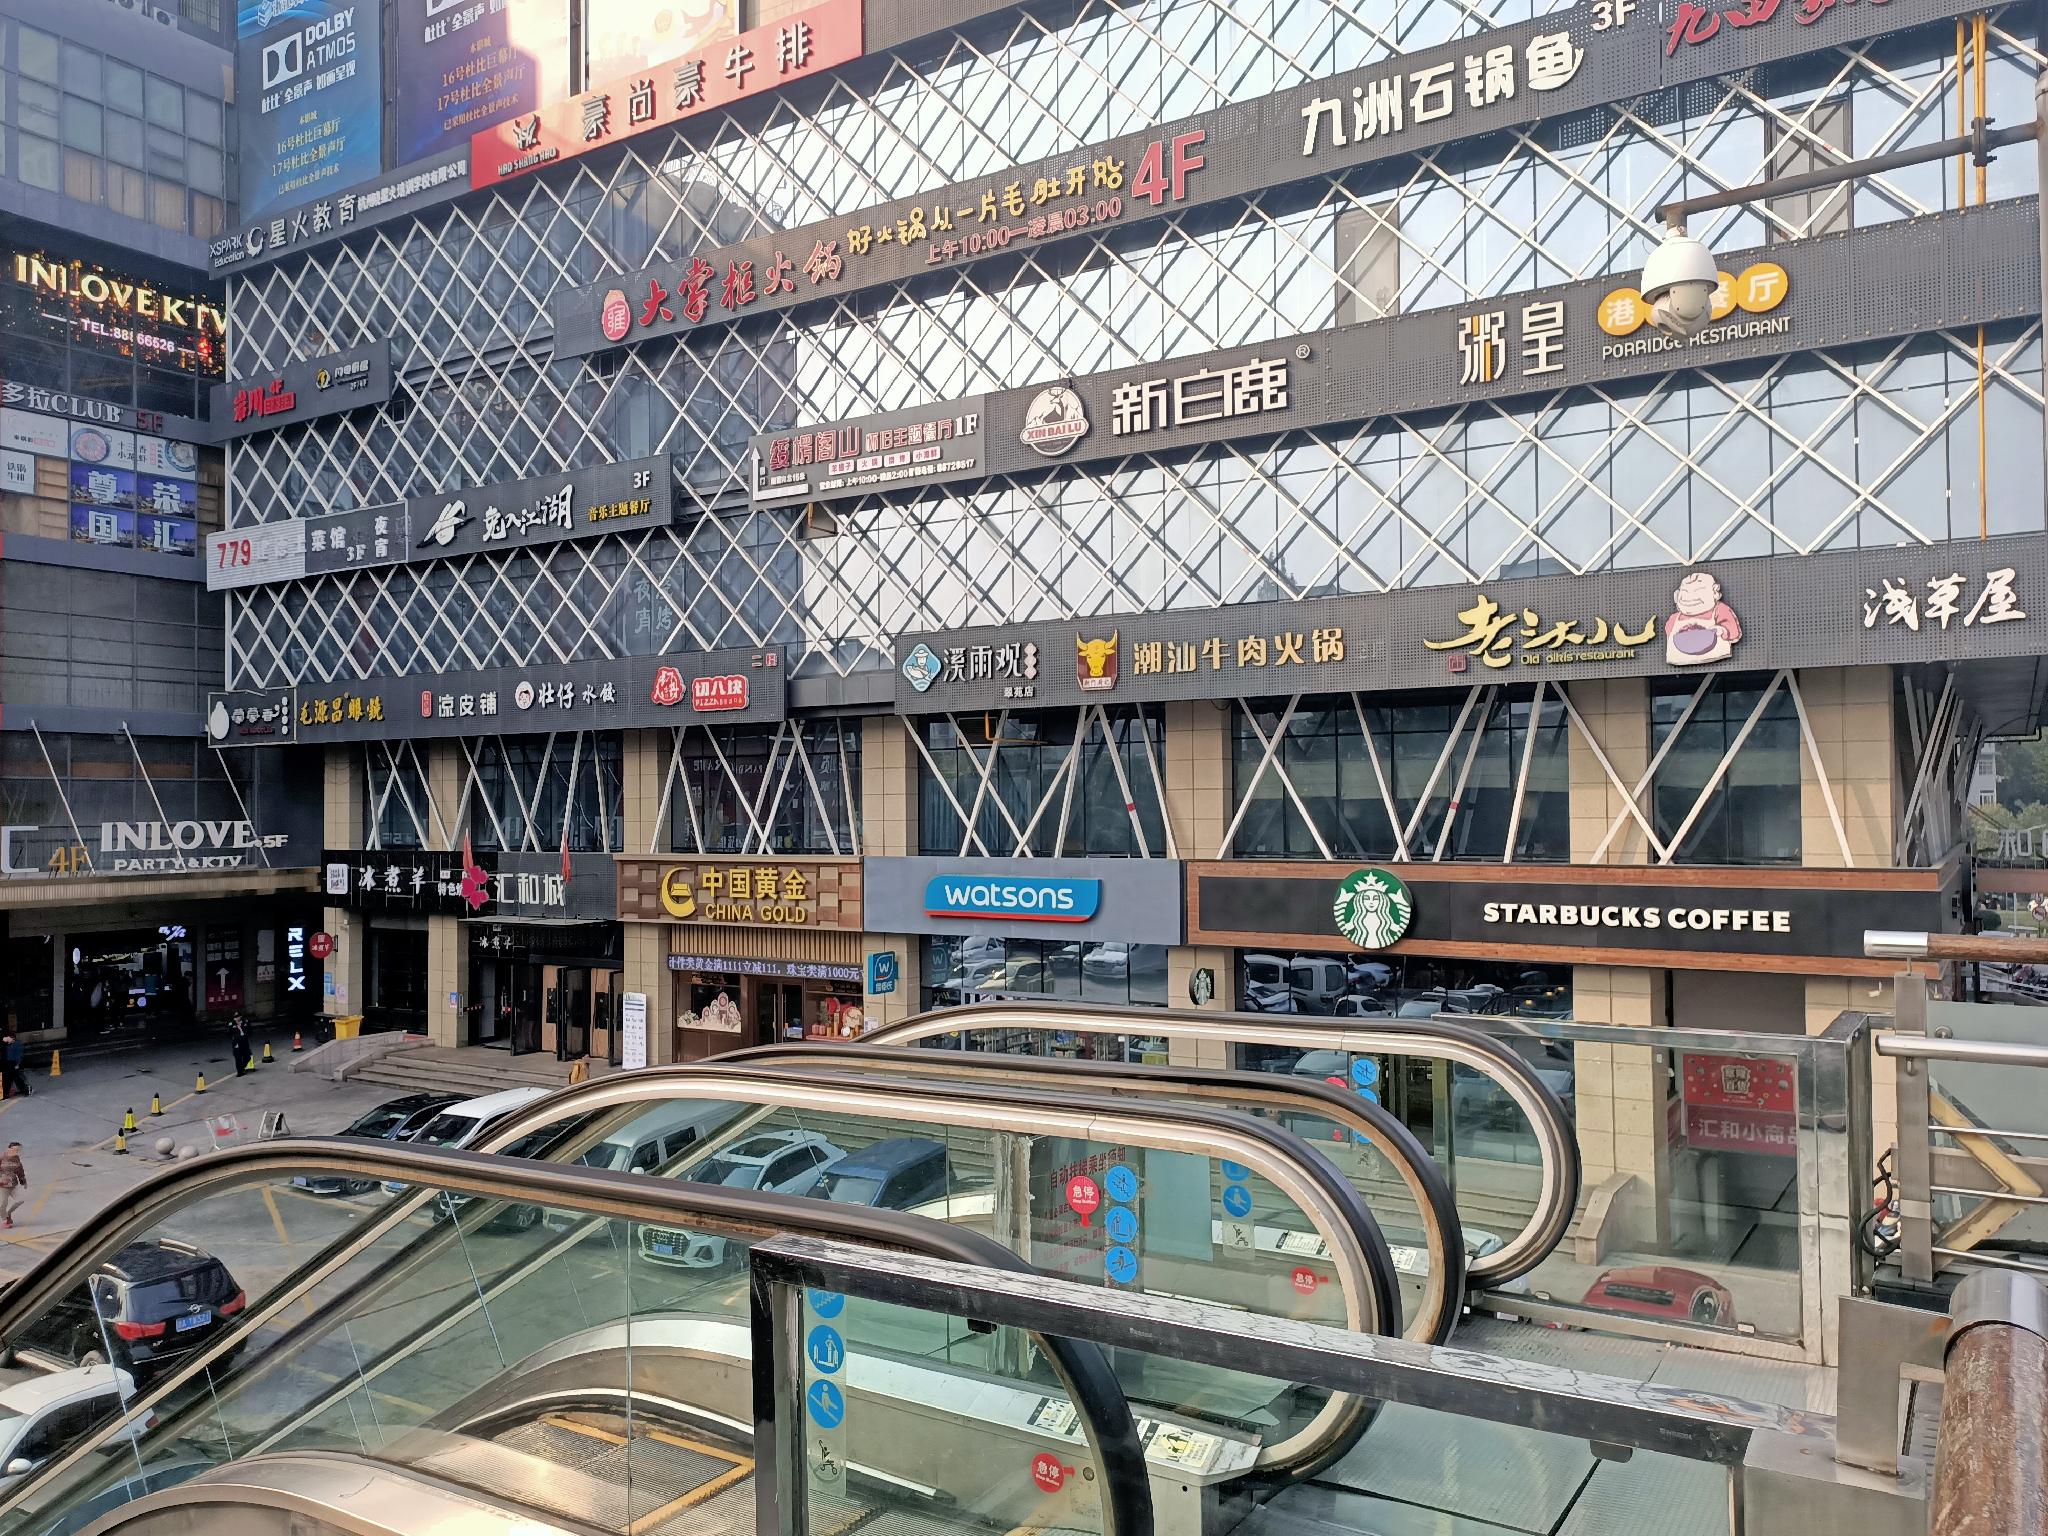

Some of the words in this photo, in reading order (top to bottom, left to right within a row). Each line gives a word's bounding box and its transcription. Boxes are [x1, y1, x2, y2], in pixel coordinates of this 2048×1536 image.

[305, 7, 355, 46] DOLBY
[1591, 0, 1635, 31] 3F
[306, 31, 356, 71] ATMOS
[582, 20, 814, 142] 豪尚豪牛排
[1301, 30, 1585, 156] 九洲石锅鱼
[276, 117, 341, 155] 16号杜比巨幕厅
[271, 136, 346, 177] 17号杜比全景声厅
[1131, 129, 1206, 206] 4F
[269, 194, 358, 250] 星火教育
[209, 234, 244, 258] XSPARK
[214, 251, 245, 268] Education
[15, 255, 157, 316] INLOVE
[162, 296, 227, 335] KTV
[1606, 271, 1780, 329] 港餐厅
[1459, 300, 1566, 386] 粥皇
[1112, 357, 1288, 435] 新白鹿
[955, 413, 978, 437] 1F
[1027, 426, 1047, 439] XIN
[1048, 424, 1066, 438] BAI
[1067, 421, 1082, 434] LU
[633, 471, 650, 489] 3F
[588, 498, 651, 522] 音乐主题餐厅
[375, 515, 389, 558] 夜宵
[217, 539, 252, 569] 779
[346, 543, 367, 562] 3F
[1863, 567, 2027, 631] 浅草屋
[943, 641, 1023, 682] 溪雨观
[1133, 626, 1345, 675] 潮汕牛肉火锅
[1521, 653, 1540, 665] Old
[1574, 648, 1636, 661] restaurant
[438, 691, 498, 718] 凉皮铺
[538, 681, 617, 710] 壮仔水饺
[1003, 685, 1035, 698] 翠苑店
[101, 820, 253, 852] INLOVE
[48, 846, 89, 876] 4F
[359, 864, 426, 895] 冰煮羊
[495, 872, 565, 908] 汇和城
[702, 866, 808, 901] 中国黄金
[944, 882, 1074, 910] watsons
[705, 903, 753, 921] CHINA
[760, 905, 807, 924] GOLD
[1483, 902, 1661, 929] STARBUCKS
[1667, 907, 1791, 933] COFFEE
[288, 927, 306, 992] RELX
[1072, 1185, 1095, 1200] 急停
[1295, 1272, 1314, 1285] 急停
[1037, 1459, 1060, 1479] 急停
